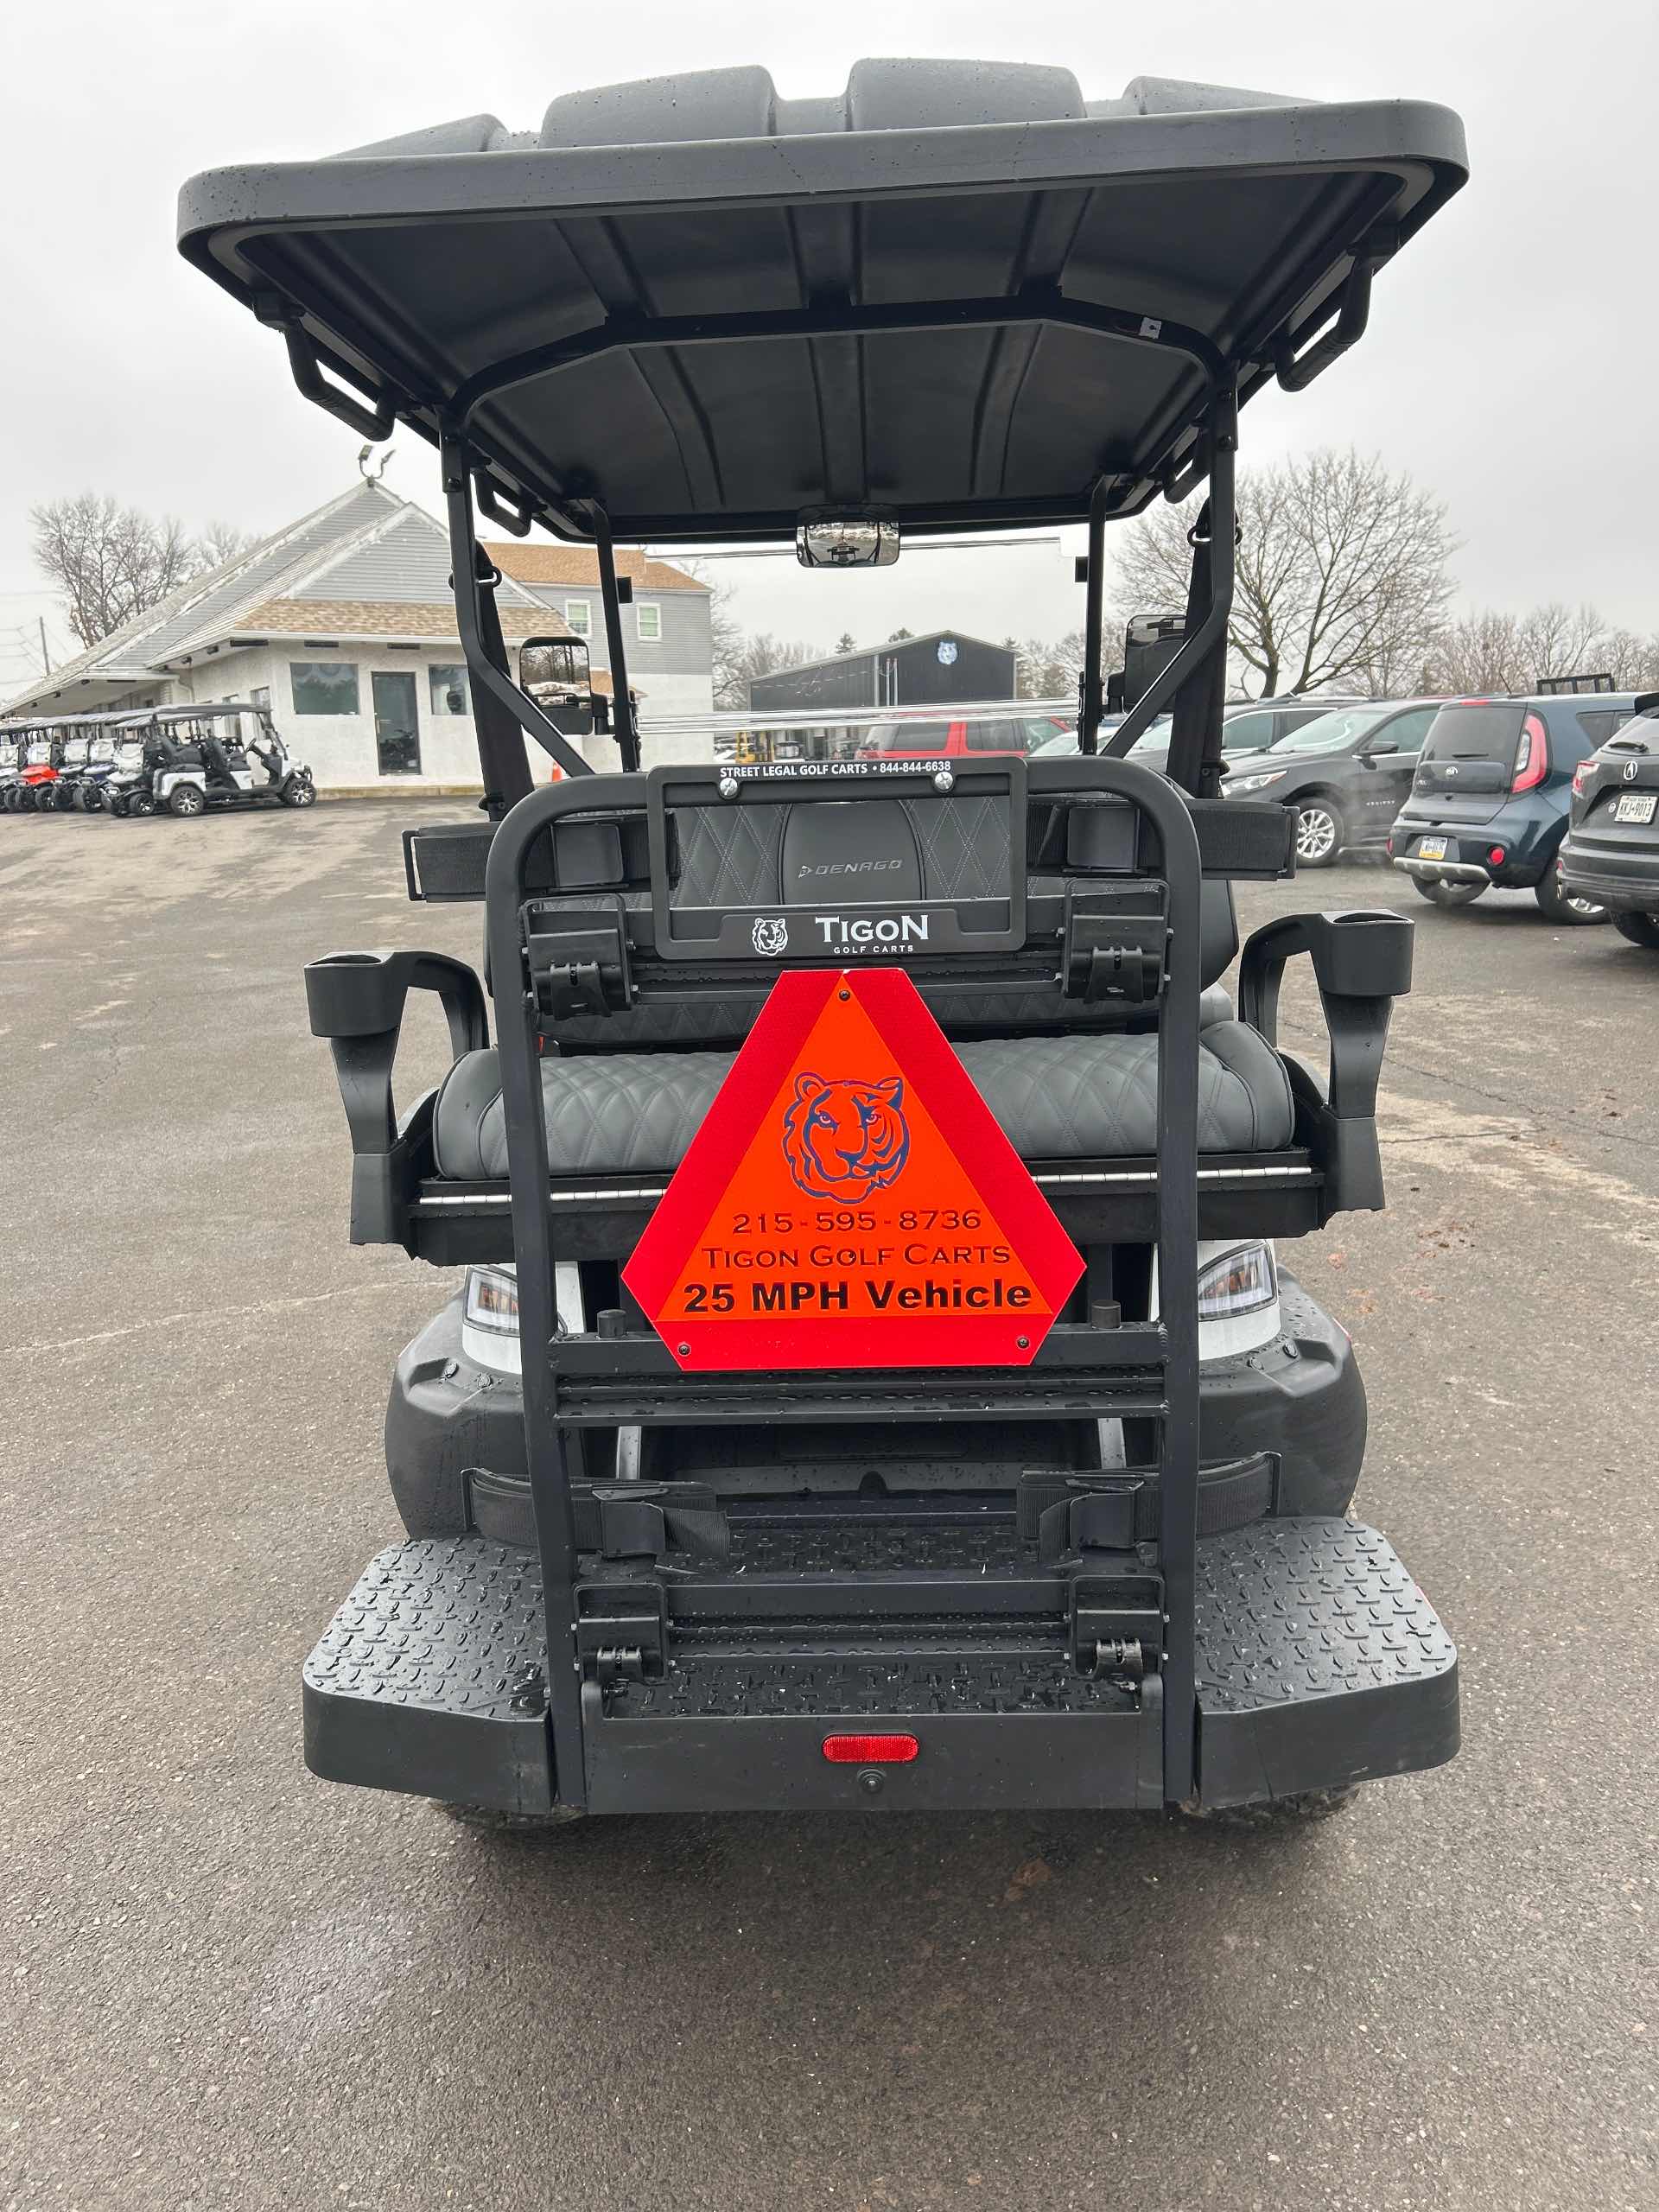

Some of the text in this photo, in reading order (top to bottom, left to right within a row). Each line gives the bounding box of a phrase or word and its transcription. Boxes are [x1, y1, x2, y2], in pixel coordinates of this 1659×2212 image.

[720, 760, 951, 778] STREET LEGAL GOLF CARTS 844-844-6638
[815, 860, 902, 874] DENAGO
[815, 914, 929, 943] TIGON
[873, 944, 913, 953] CARTS
[683, 1278, 1032, 1313] 25 MPH Vehicle
